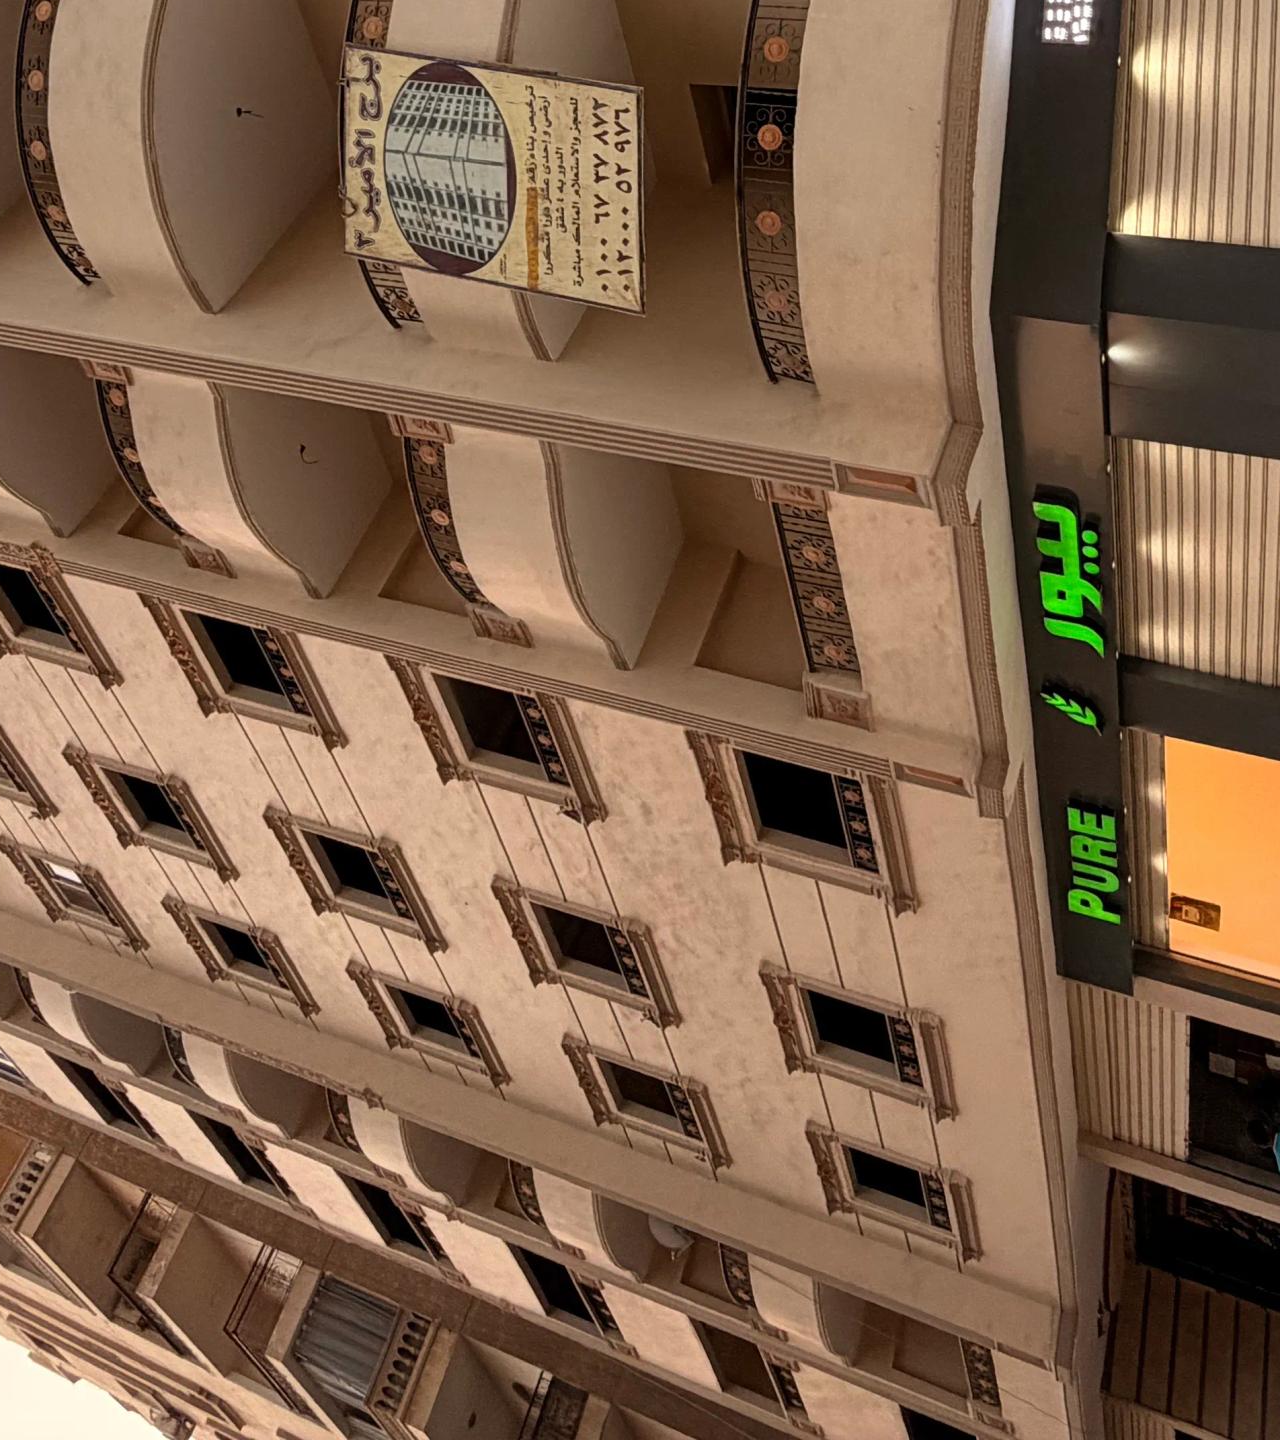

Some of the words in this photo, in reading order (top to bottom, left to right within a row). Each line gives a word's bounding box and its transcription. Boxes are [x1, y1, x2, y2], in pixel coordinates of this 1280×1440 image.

[359, 54, 382, 120] برج
[525, 85, 536, 133] ترخيص
[570, 97, 581, 135] للحجز
[592, 97, 609, 146] ٨٧٢
[614, 107, 631, 153] ٩٧٦
[526, 136, 536, 159] بناء
[556, 147, 566, 178] الدور
[348, 129, 381, 232] الأمير
[615, 163, 632, 194] ٥٢
[556, 207, 567, 233] شقق
[572, 202, 581, 246] المالك
[593, 194, 610, 224] ٦٧
[354, 231, 375, 249] ٣
[616, 206, 633, 292] ٠١٢٠٠٠
[573, 249, 583, 287] مباشرة
[596, 238, 611, 292] ٠١٠٠
[1032, 500, 1105, 657] بيور
[1066, 806, 1121, 925] PURE
